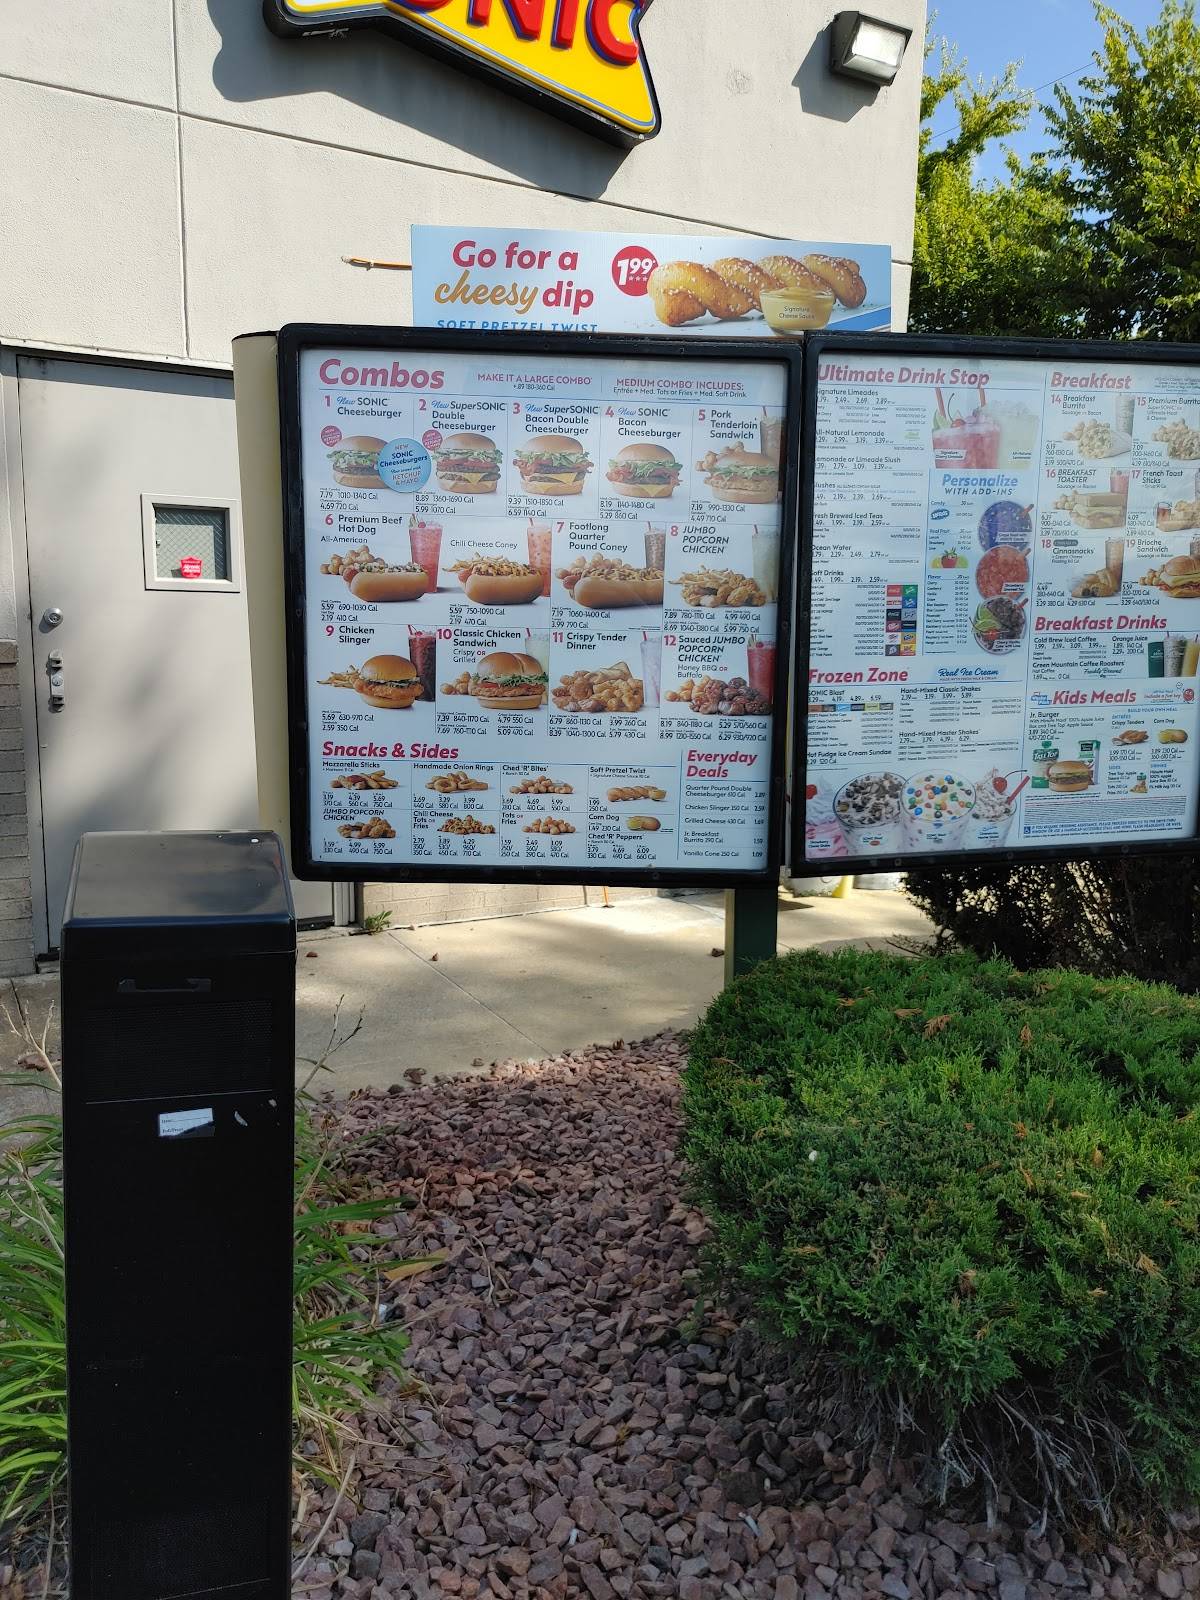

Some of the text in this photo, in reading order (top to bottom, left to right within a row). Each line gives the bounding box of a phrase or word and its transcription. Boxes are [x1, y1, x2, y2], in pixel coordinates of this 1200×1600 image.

[452, 240, 578, 270] Go for a
[434, 270, 594, 315] cheesy dip
[320, 359, 444, 389] Combos
[818, 364, 990, 388] Ultimate Drink Stop
[617, 379, 655, 387] MEDIUM
[697, 382, 743, 390] INCLUDES:
[1051, 372, 1132, 389] Breakfast
[325, 396, 330, 407] 1
[337, 397, 355, 405] New
[419, 399, 426, 411] 2
[432, 400, 506, 411] New SuperSONIC
[1148, 397, 1177, 405] Premium
[338, 407, 402, 418] Cheeseburger
[513, 403, 520, 414] 3
[525, 404, 598, 414] New SuperSONIC
[606, 406, 614, 417] 4
[617, 407, 668, 417] New SONIC
[432, 411, 464, 420] Double
[526, 414, 588, 424] Bacon Double
[699, 410, 705, 420] 5
[711, 410, 731, 418] Pork
[432, 421, 496, 432] Cheeseburger
[618, 418, 647, 426] Bacon
[711, 419, 757, 429] Tenderloin
[525, 424, 588, 436] Cheeseburger
[618, 428, 681, 438] Cheeseburger
[710, 430, 753, 439] Sandwich
[380, 455, 428, 467] Cheeseburgers
[393, 471, 421, 480] KETCHUP
[1046, 470, 1056, 478] 16
[1131, 470, 1141, 479] 17
[942, 474, 1018, 487] Personalize
[325, 514, 333, 525] 6
[339, 515, 402, 524] Premium Beef
[358, 526, 376, 535] Dog
[557, 522, 564, 533] 7
[569, 522, 608, 533] Footlong
[671, 526, 678, 536] 8
[682, 526, 716, 534] JUMBO
[569, 532, 605, 541] Quarter
[570, 542, 628, 552] Pound Coney
[1042, 539, 1051, 548] 18
[1126, 539, 1136, 548] 19
[682, 546, 724, 554] CHICKEN
[1035, 615, 1167, 631] Breakfast Drinks
[339, 626, 374, 634] Chicken
[437, 629, 452, 639] 10
[453, 629, 521, 638] Classic Chicken
[339, 636, 370, 645] Slinger
[553, 632, 563, 642] 11
[567, 632, 627, 642] Crispy Tender
[664, 635, 676, 646] 12
[713, 636, 746, 644] JUMBO
[453, 639, 497, 648] Sandwich
[678, 654, 719, 662] CHICKEN
[809, 668, 908, 683] Frozen Zone
[938, 668, 999, 677] Real Ice Cream
[1053, 691, 1087, 705] Kids
[1091, 689, 1136, 703] Meals
[323, 741, 458, 759] Snacks & Sides
[688, 750, 758, 766] Everyday
[687, 766, 728, 777] Deals
